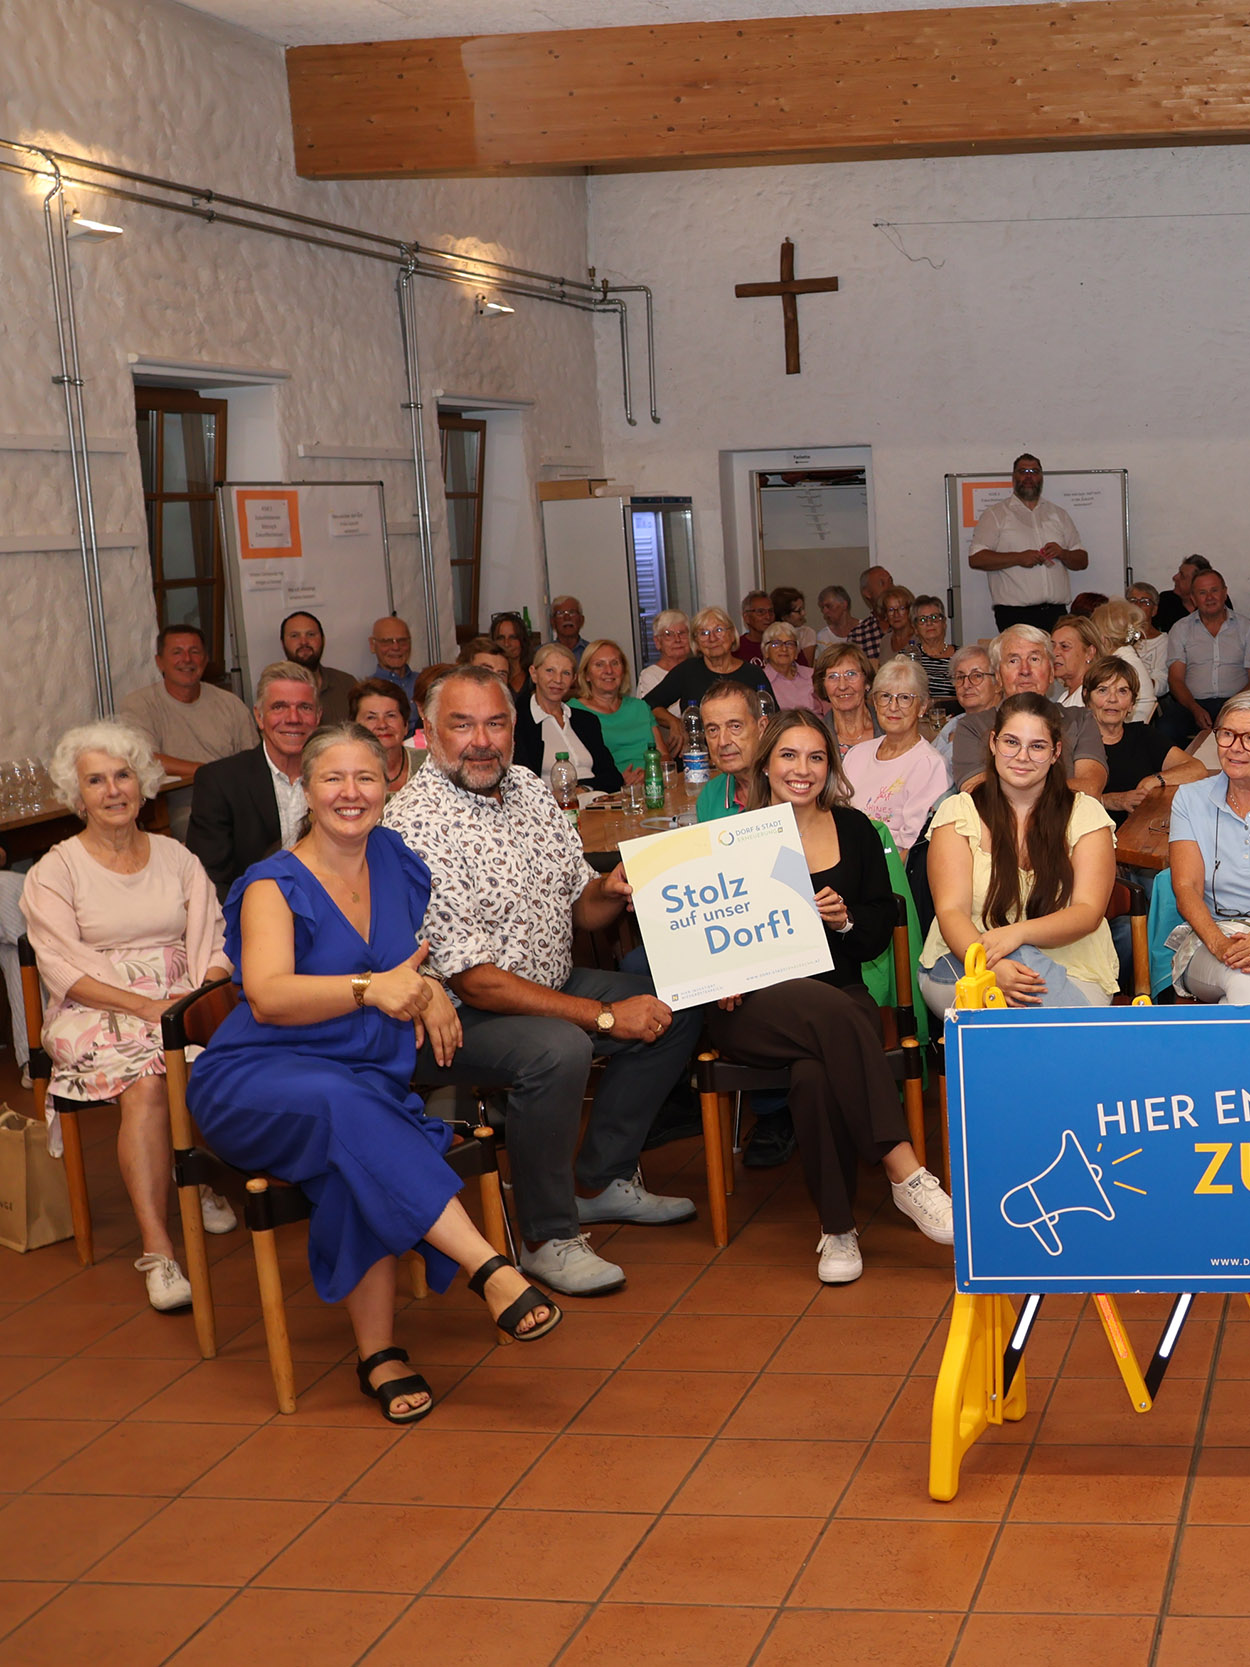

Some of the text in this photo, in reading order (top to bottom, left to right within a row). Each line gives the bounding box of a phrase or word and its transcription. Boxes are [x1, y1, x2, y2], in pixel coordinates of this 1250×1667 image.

[735, 826, 754, 836] DORF
[761, 820, 781, 830] STADT
[662, 872, 748, 914] Stolz
[670, 901, 751, 931] auf unser
[704, 908, 794, 955] Dorf!
[1097, 1094, 1199, 1136] HIER
